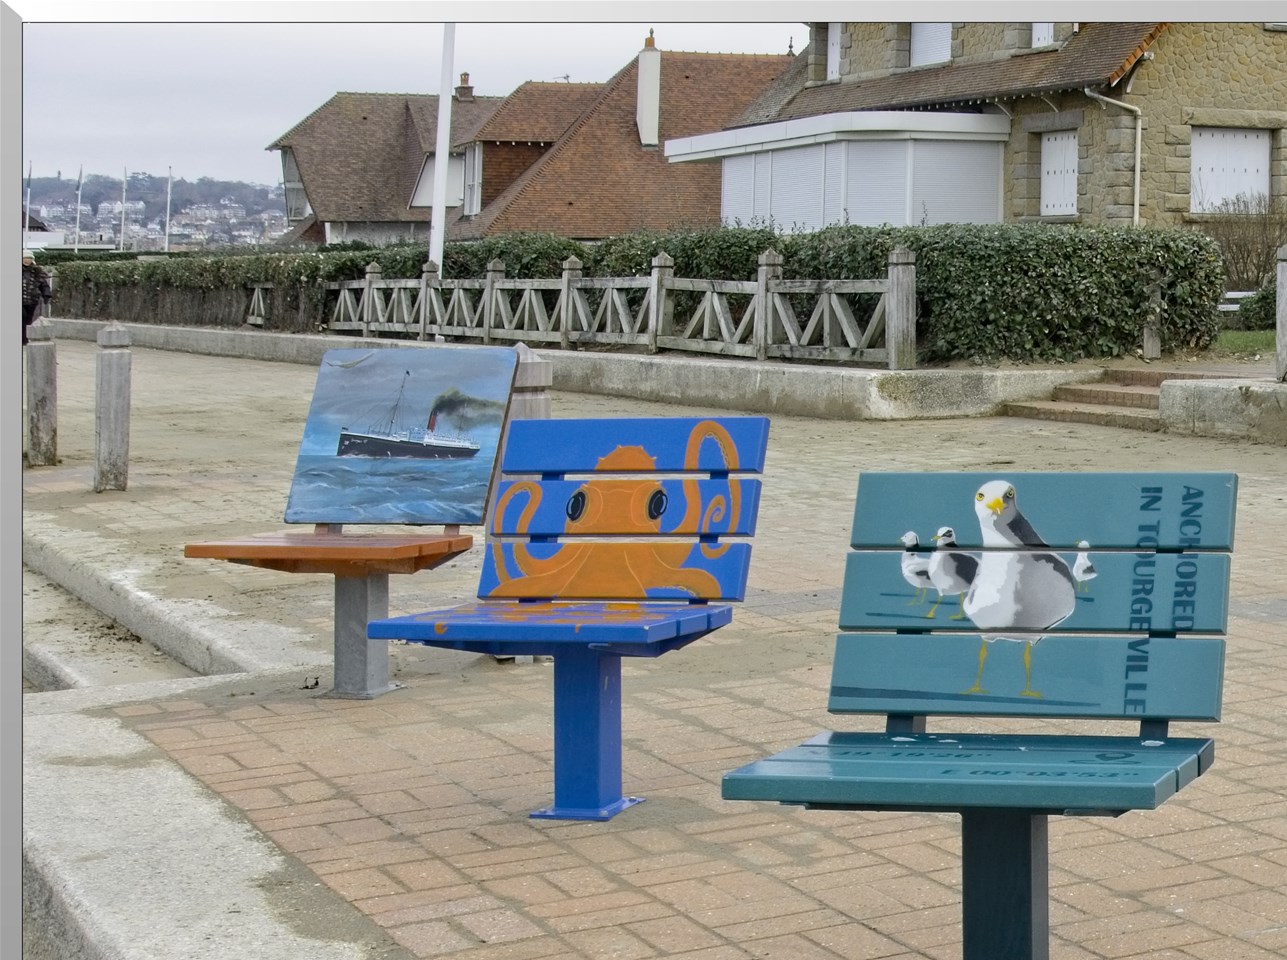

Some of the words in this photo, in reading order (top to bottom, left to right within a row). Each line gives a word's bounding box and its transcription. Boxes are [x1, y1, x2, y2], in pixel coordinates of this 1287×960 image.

[1139, 486, 1163, 512] IN
[1172, 485, 1205, 631] ANCHORED
[1123, 520, 1161, 715] TOURGEVILLE
